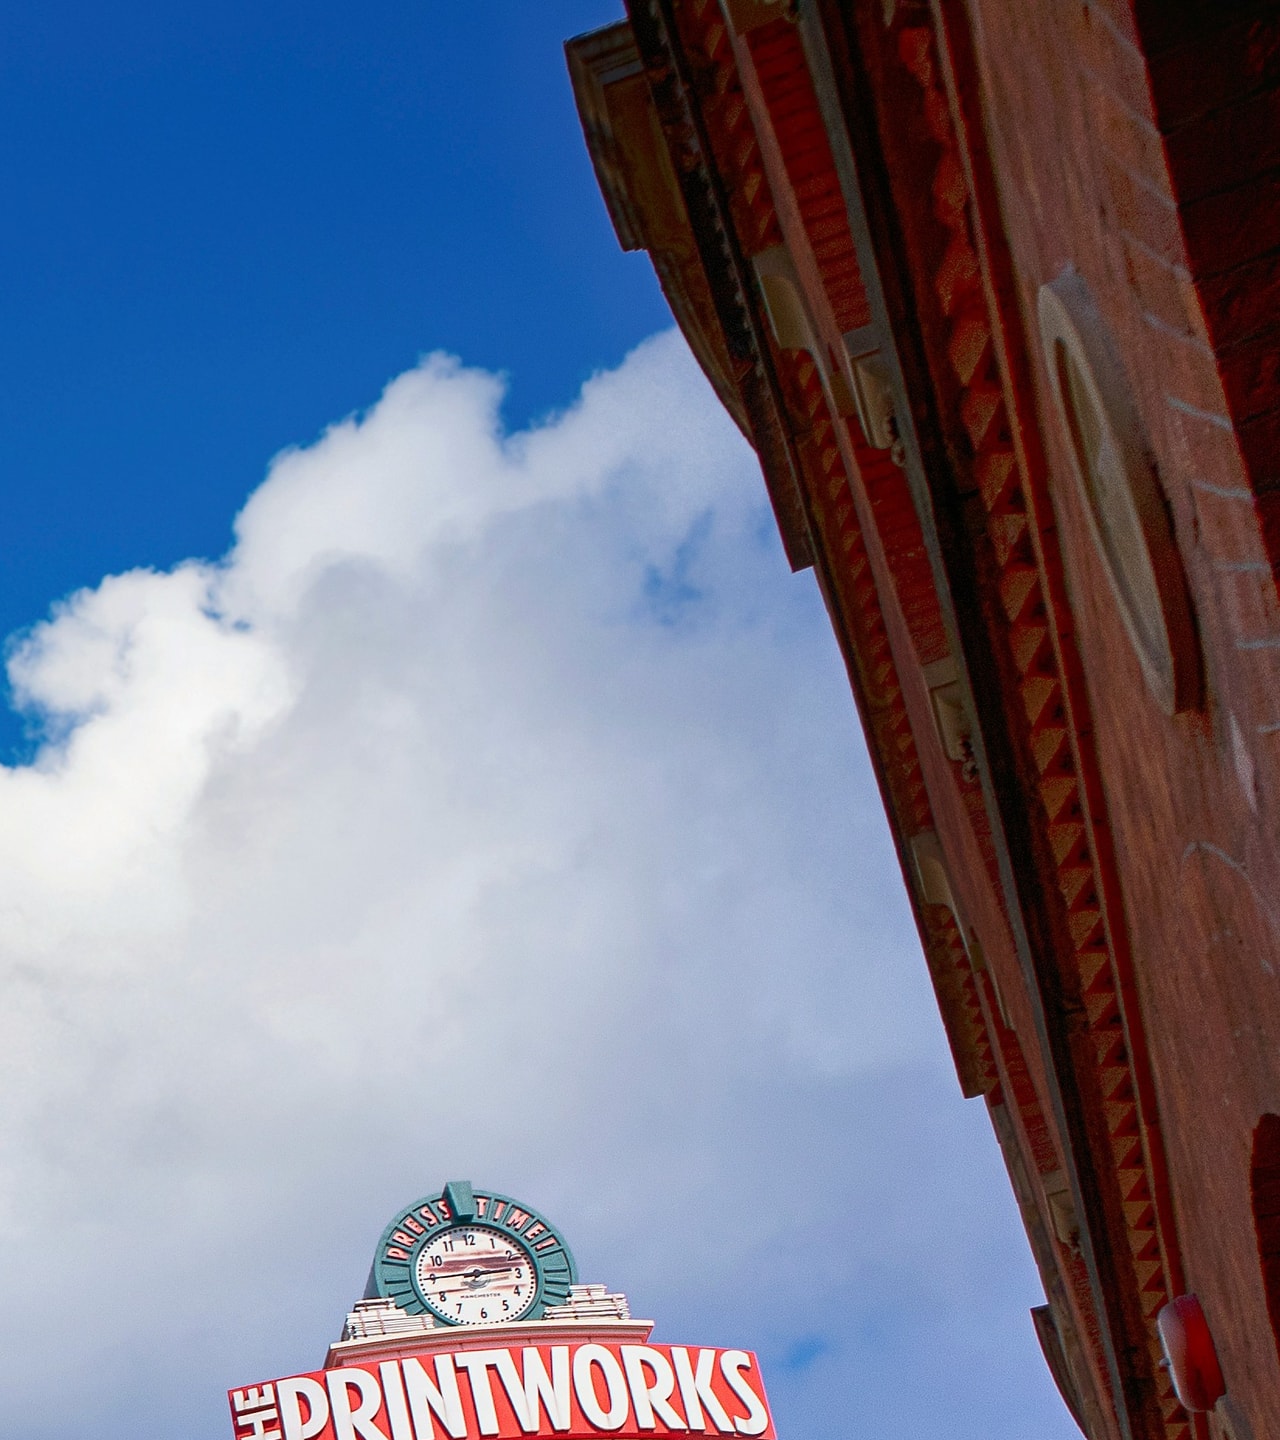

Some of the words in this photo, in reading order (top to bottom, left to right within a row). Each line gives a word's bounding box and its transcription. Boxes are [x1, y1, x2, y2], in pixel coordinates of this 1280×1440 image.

[386, 1198, 452, 1261] PRESS
[443, 1240, 454, 1252] 11
[463, 1234, 476, 1247] 12
[430, 1255, 442, 1267] 10
